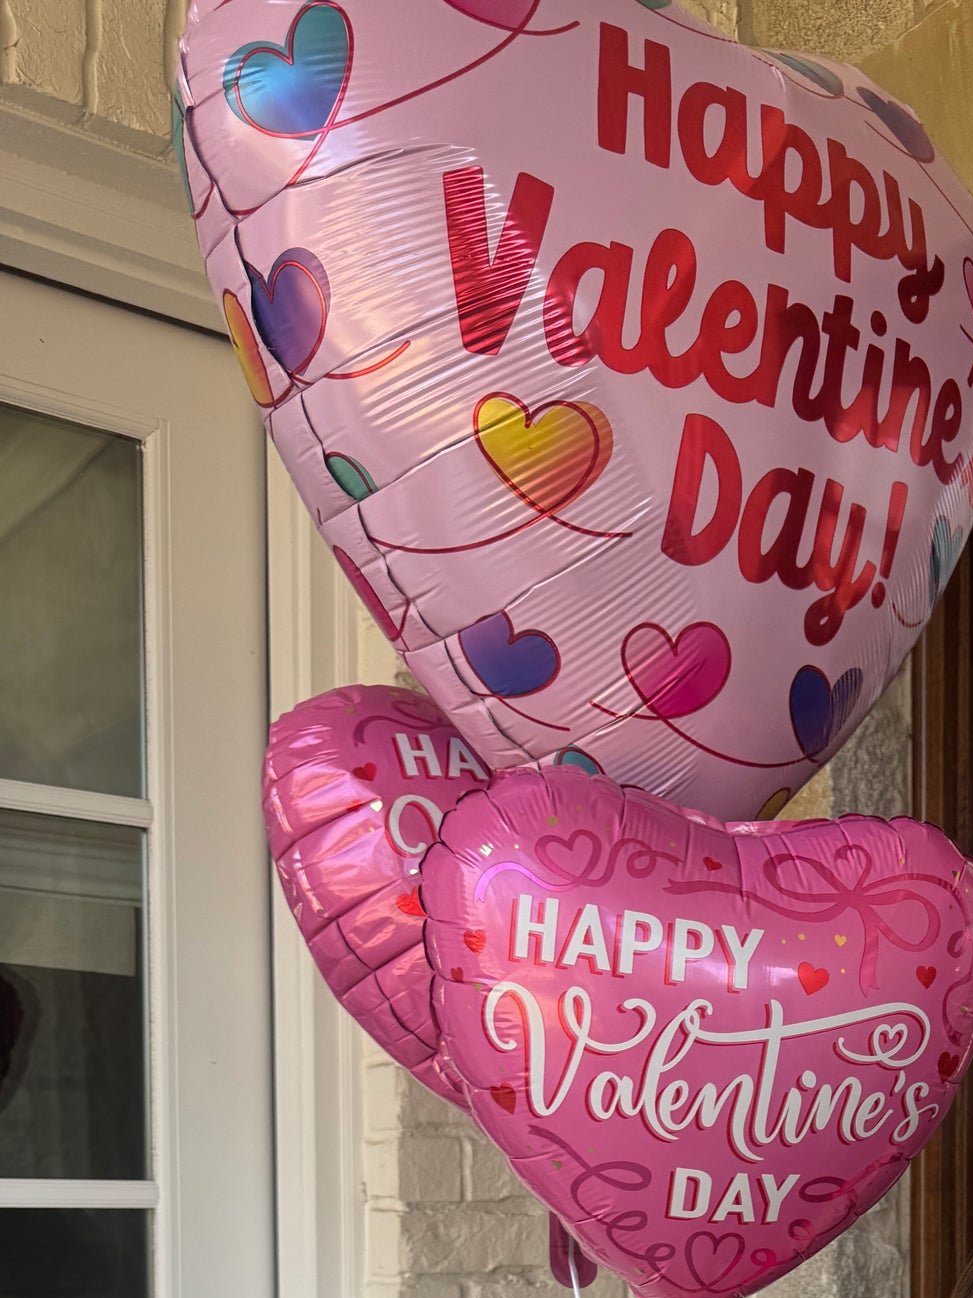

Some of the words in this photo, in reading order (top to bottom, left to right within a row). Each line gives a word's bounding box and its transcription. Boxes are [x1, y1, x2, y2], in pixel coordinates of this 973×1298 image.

[599, 21, 944, 325] Happy
[660, 413, 910, 646] Day!
[392, 733, 488, 783] HA
[509, 893, 765, 993] HAPPY
[482, 981, 940, 1162] Valentine's
[665, 1167, 800, 1224] DAY
